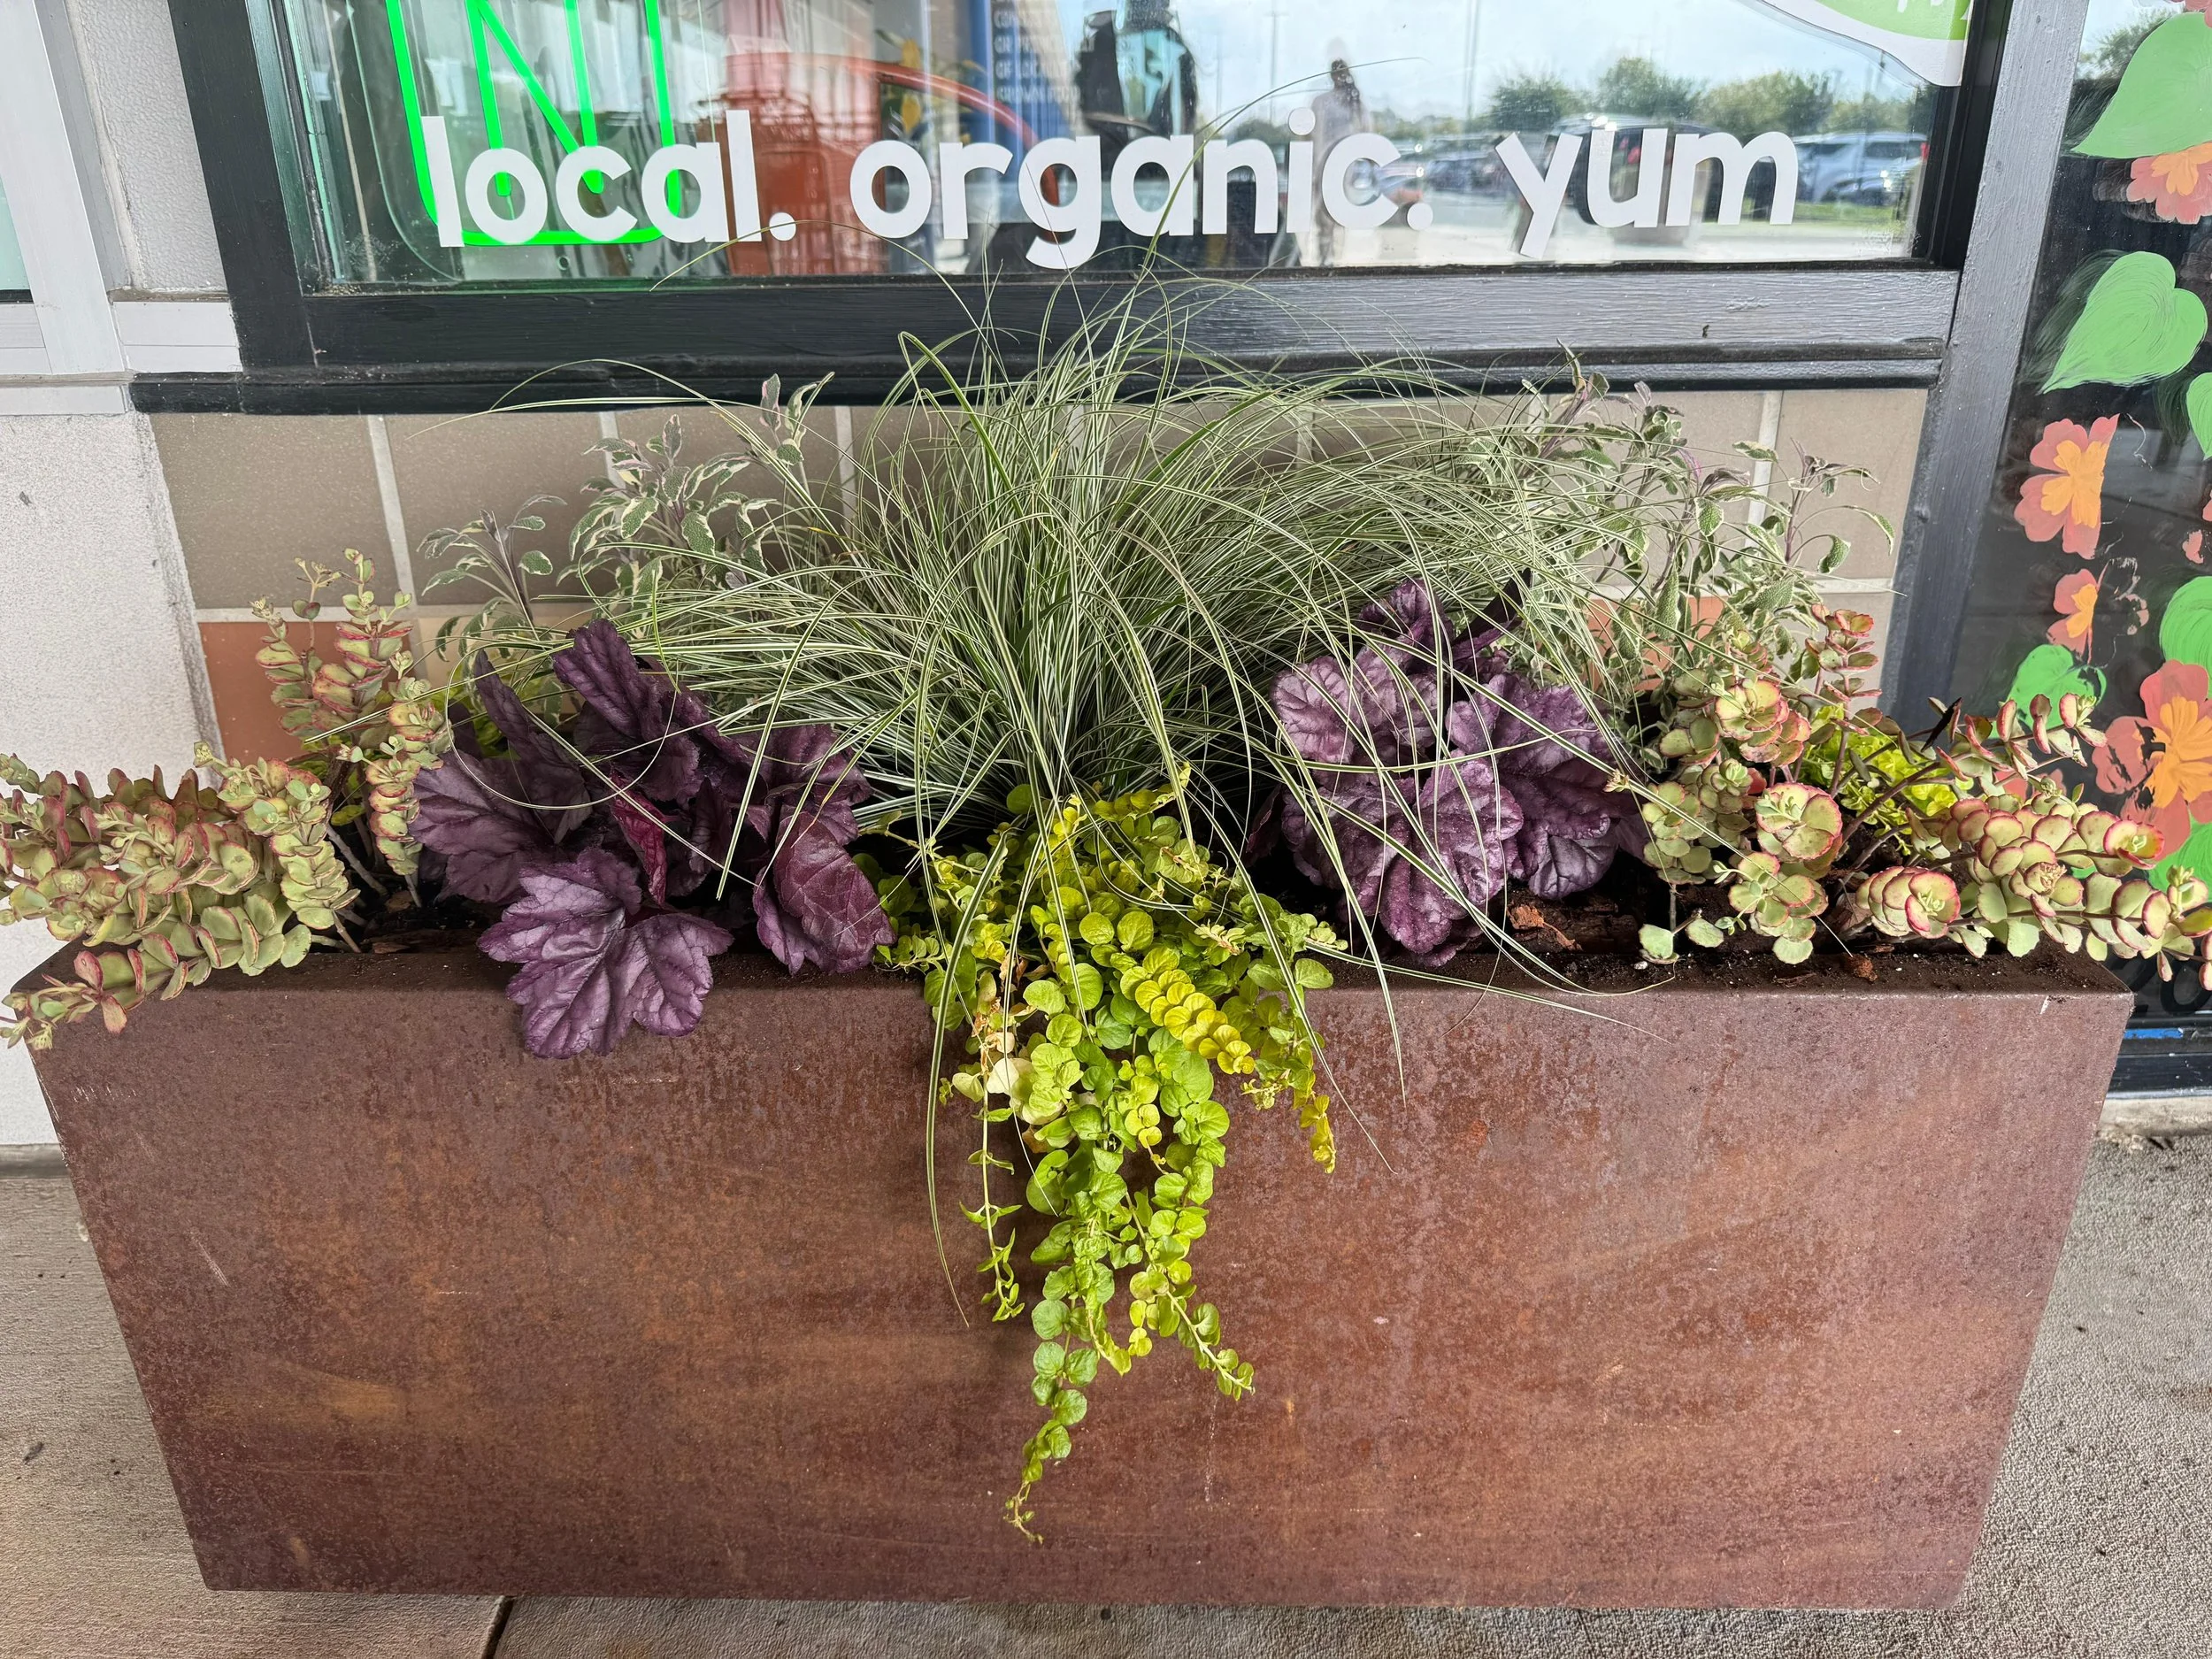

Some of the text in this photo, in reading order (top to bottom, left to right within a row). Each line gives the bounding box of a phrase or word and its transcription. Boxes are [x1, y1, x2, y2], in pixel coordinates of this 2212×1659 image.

[421, 106, 1799, 268] local. organic. yum
